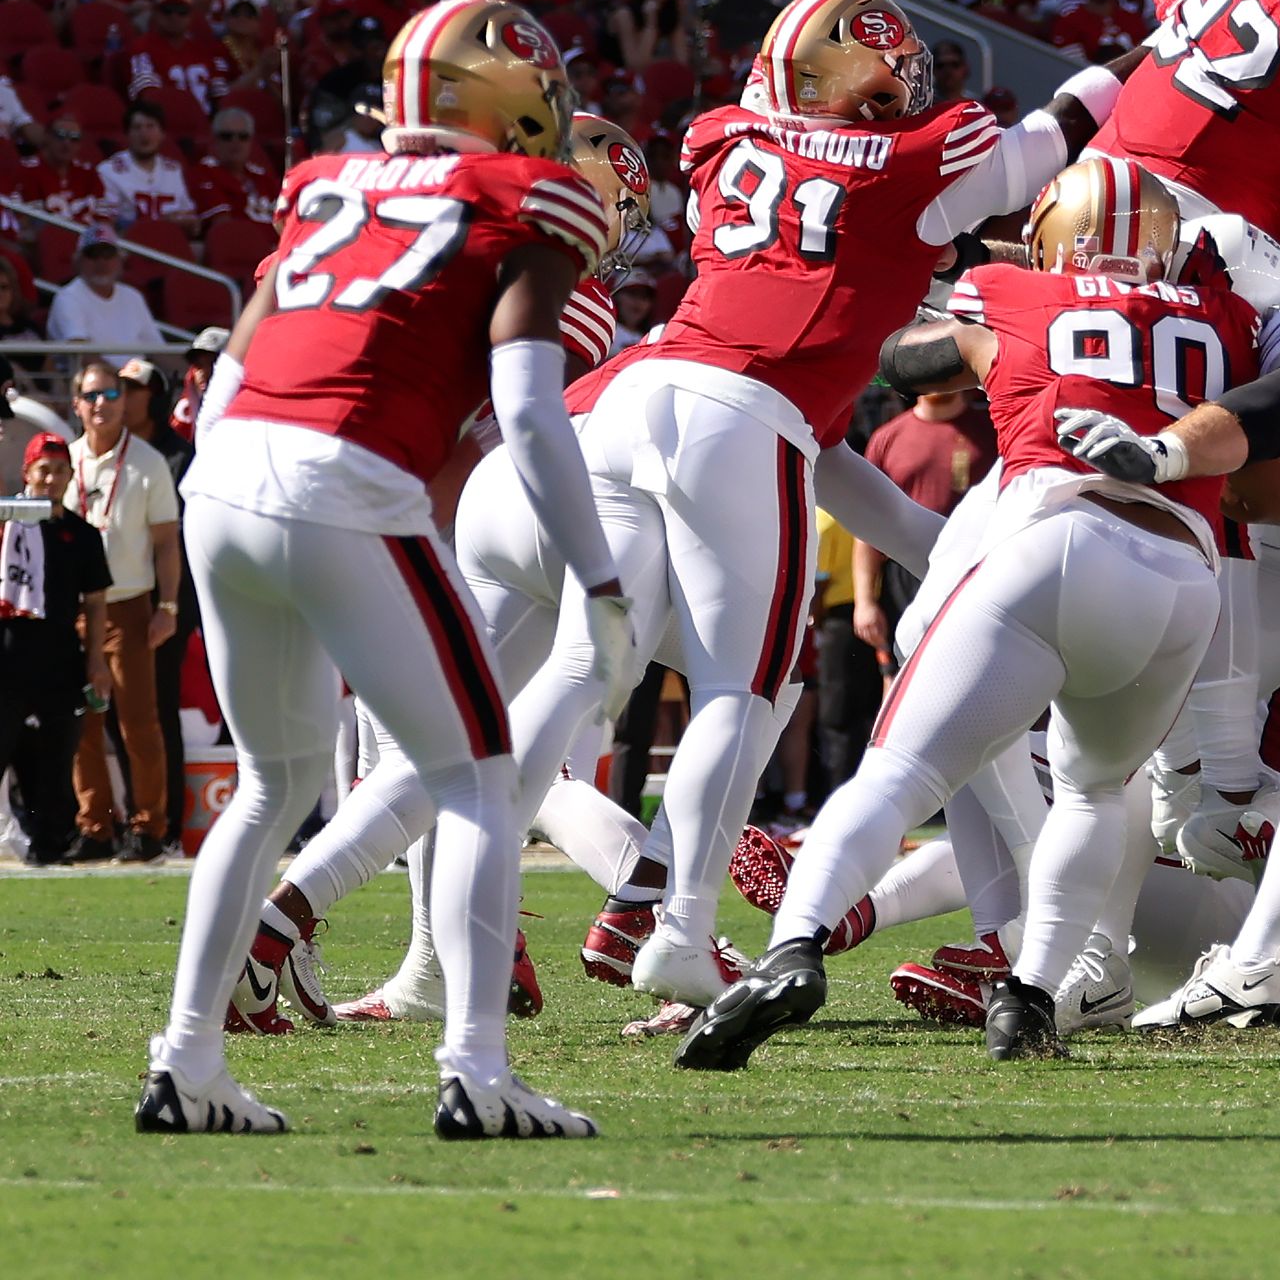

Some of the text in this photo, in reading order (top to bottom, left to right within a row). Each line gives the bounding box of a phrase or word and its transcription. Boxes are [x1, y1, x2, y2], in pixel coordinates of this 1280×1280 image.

[859, 11, 899, 46] SF
[335, 156, 460, 191] BROWN
[713, 138, 846, 260] 91
[274, 178, 470, 311] 27
[1074, 256, 1089, 270] 37
[1074, 276, 1200, 307] GIVENS
[1047, 308, 1232, 420] 90
